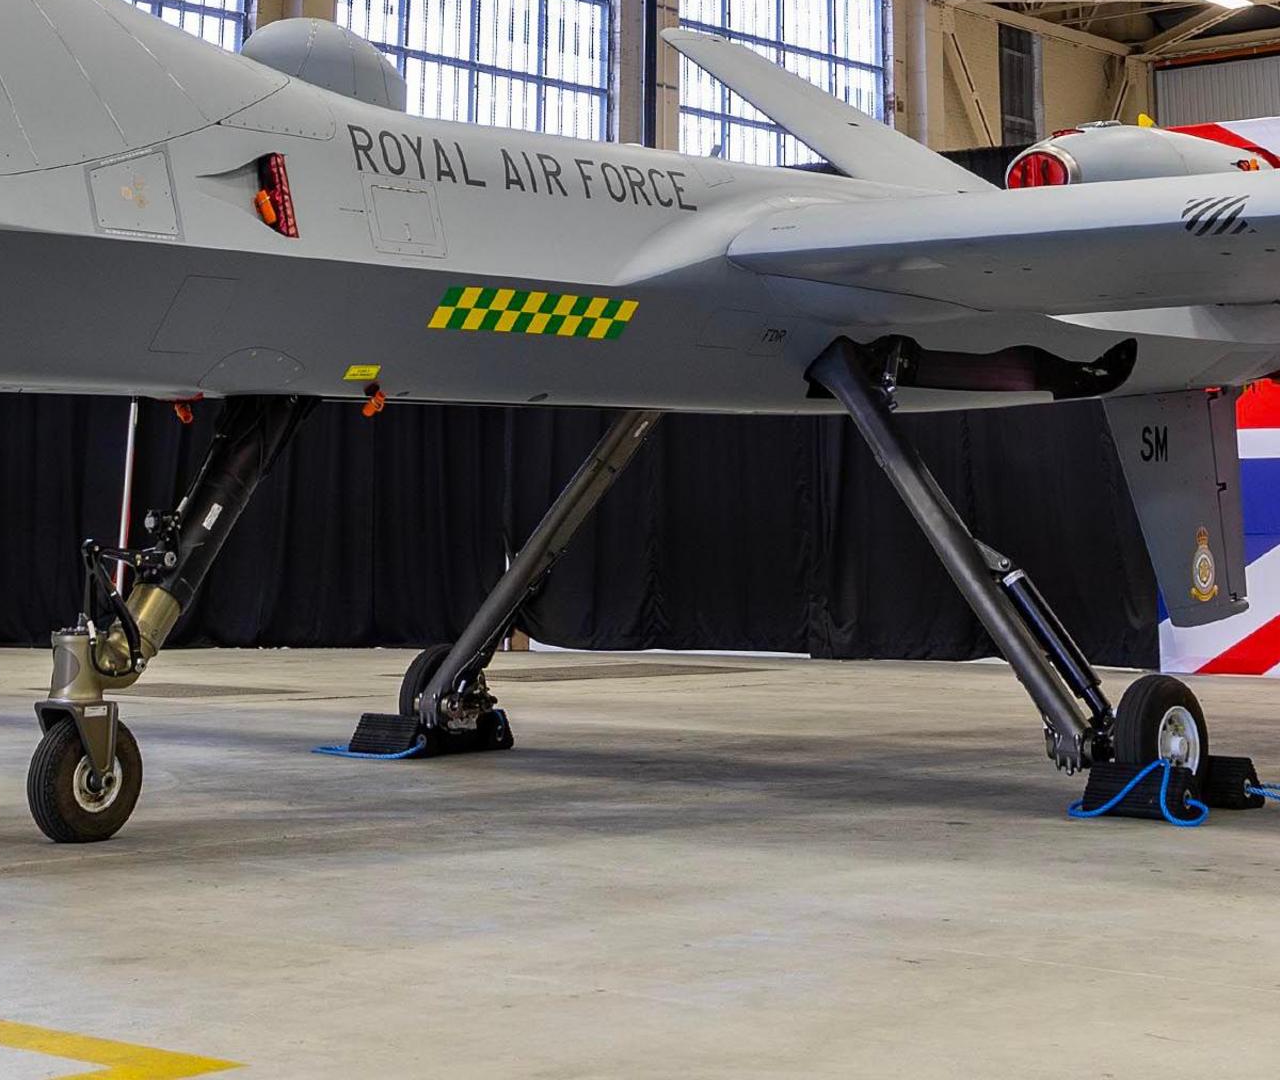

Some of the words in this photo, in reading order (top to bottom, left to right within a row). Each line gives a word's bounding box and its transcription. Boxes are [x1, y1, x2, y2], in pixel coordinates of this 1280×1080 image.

[348, 124, 486, 188] ROYAL
[501, 148, 568, 197] AIR
[575, 159, 698, 212] FORCE
[1141, 426, 1168, 462] SM
